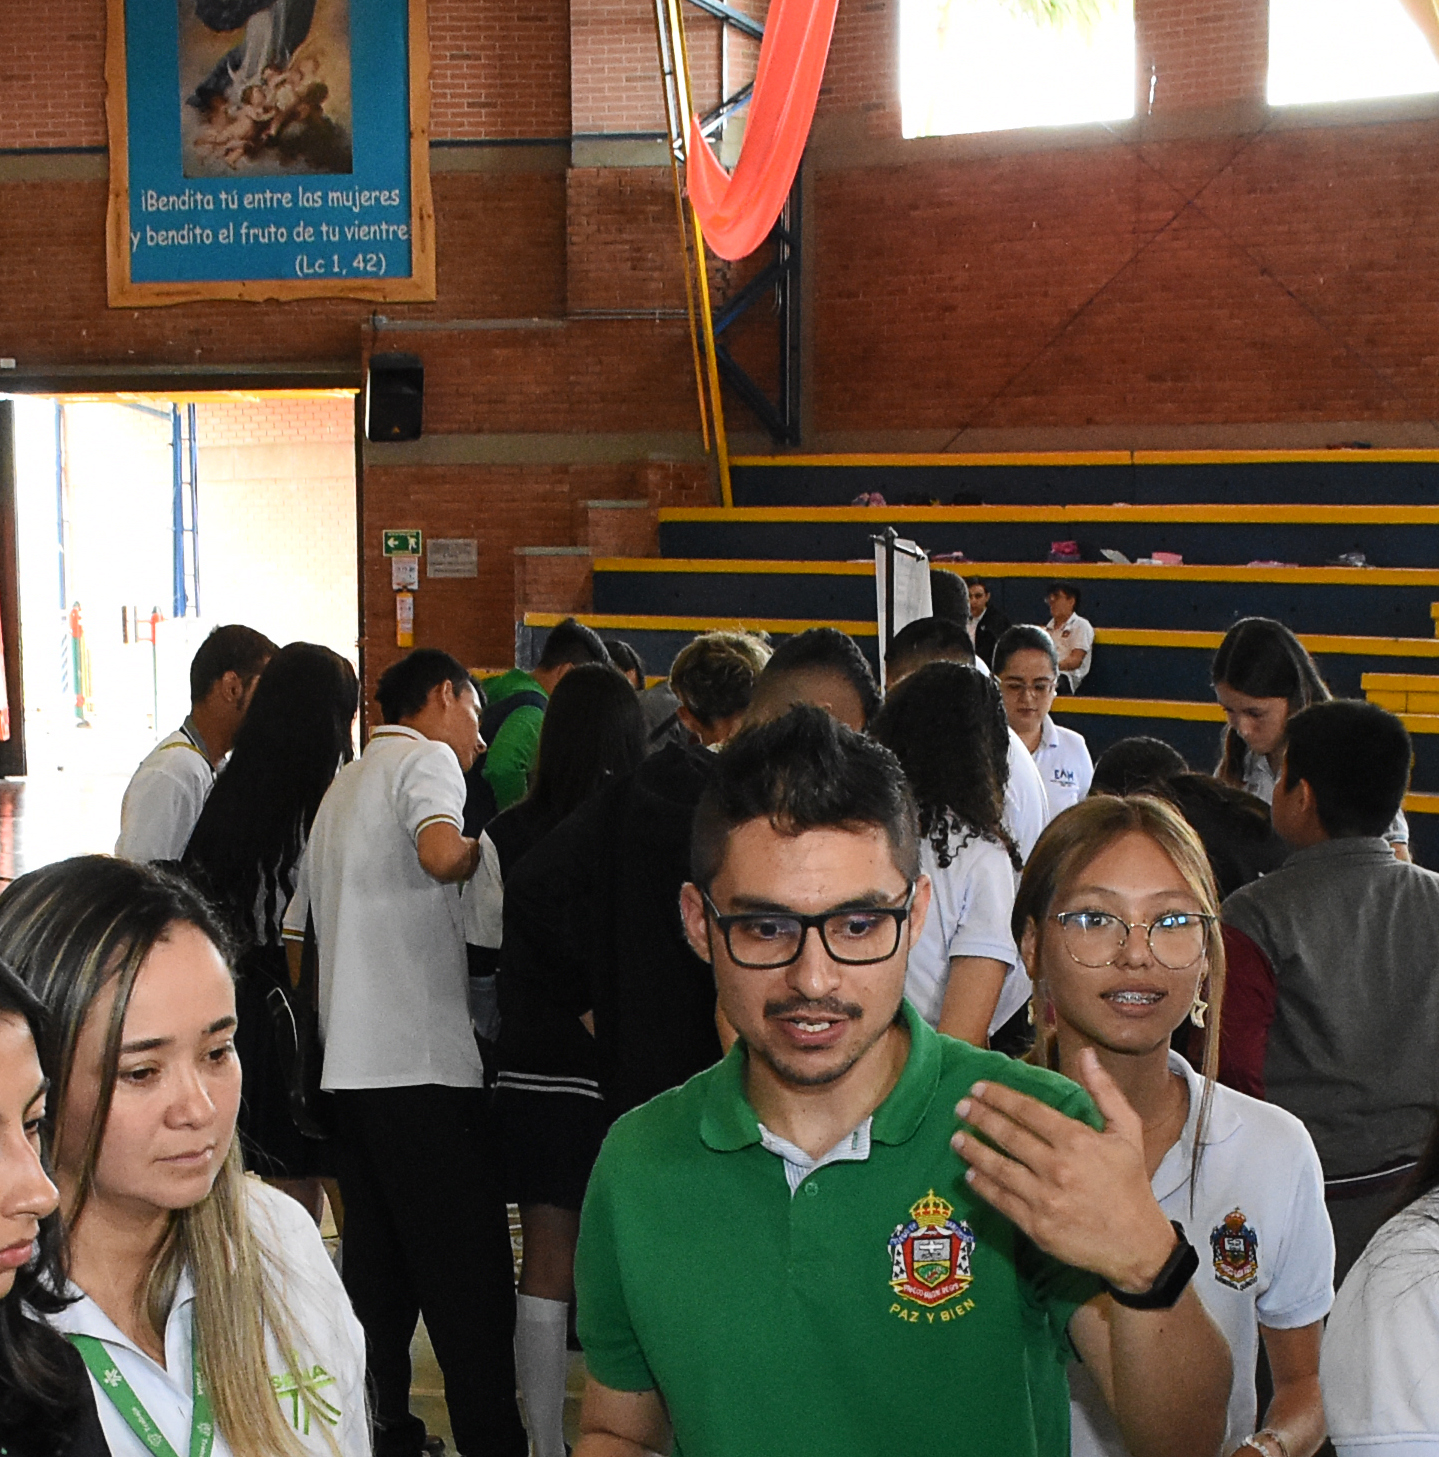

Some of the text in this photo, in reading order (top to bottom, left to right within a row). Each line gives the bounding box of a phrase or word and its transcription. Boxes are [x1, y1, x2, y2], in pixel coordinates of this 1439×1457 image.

[219, 190, 238, 210] tú
[243, 189, 293, 209] entre
[298, 186, 323, 207] las
[328, 187, 400, 213] mujeres
[131, 220, 409, 252] y bendito el fruto de tu vientre
[295, 253, 386, 276] (Lc 1, 42)
[889, 1299, 975, 1324] PAZ Y BIEN
[272, 1365, 327, 1388] SEA
